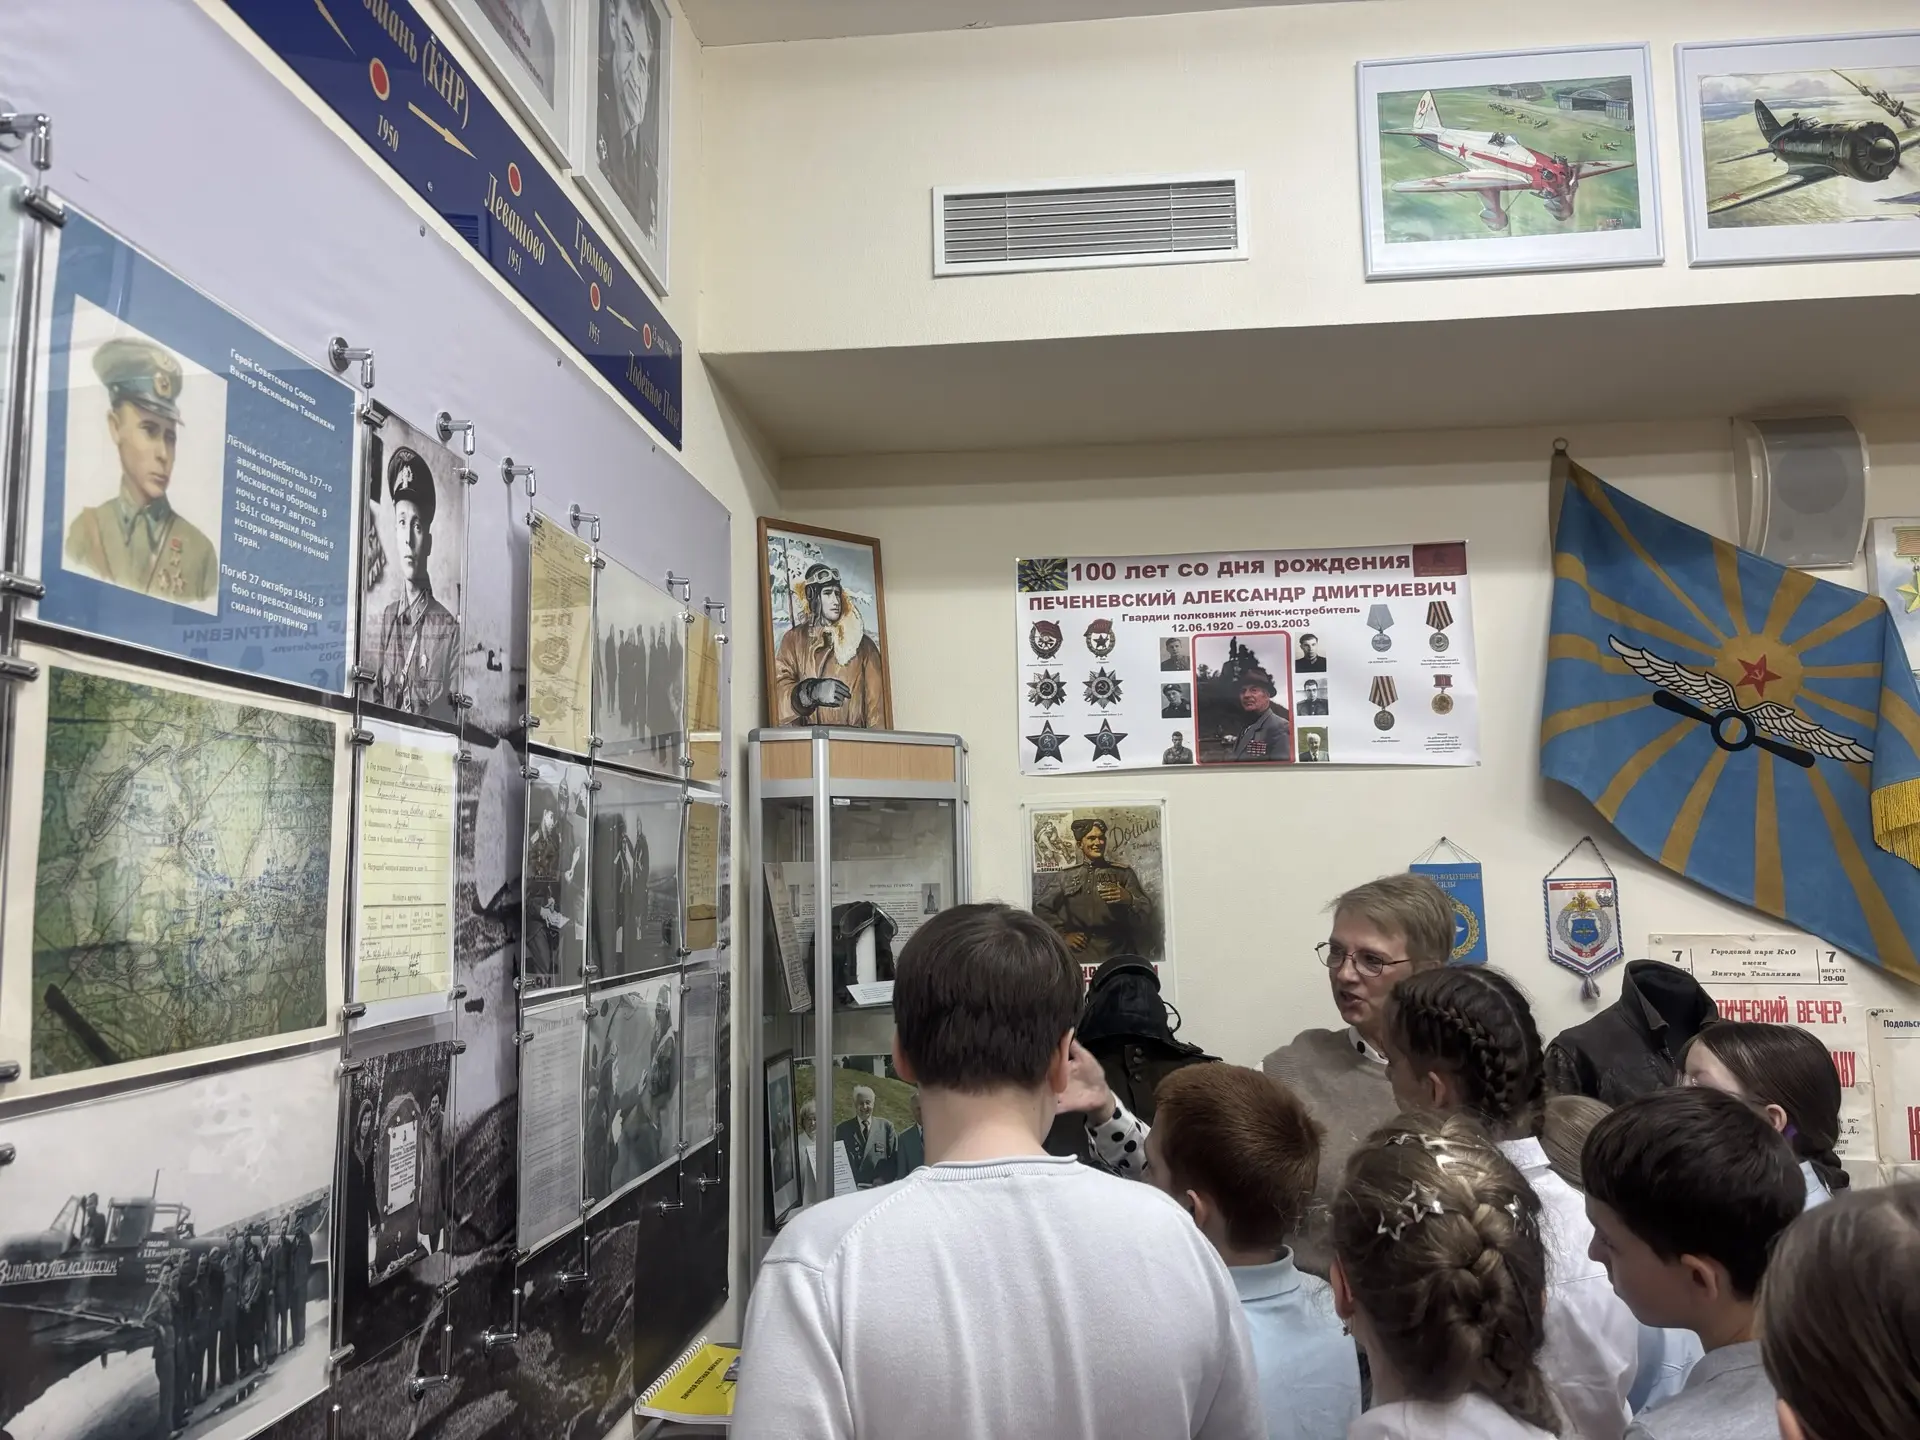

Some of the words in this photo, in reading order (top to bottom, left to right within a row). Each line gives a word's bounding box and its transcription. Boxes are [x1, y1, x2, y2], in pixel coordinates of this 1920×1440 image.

[363, 0, 417, 64] шань
[422, 40, 469, 130] (КНР)
[377, 114, 399, 152] 1950
[484, 172, 546, 266] Левашово
[507, 246, 523, 276] 1951
[574, 217, 613, 288] Громово
[588, 321, 600, 345] 1955
[230, 348, 253, 368] Герой
[254, 362, 294, 393] Советского
[294, 387, 316, 406] Союза
[625, 349, 663, 412] Лодейное
[662, 388, 681, 431] Поле
[229, 364, 257, 389] Виктор
[258, 381, 300, 412] Васильевич
[300, 404, 336, 432] Талалихин
[226, 433, 309, 482] Лётчик-истребитель
[309, 472, 334, 493] 177-го
[236, 455, 294, 489] авиационного
[294, 482, 317, 500] полка
[235, 486, 256, 502] ночь
[256, 494, 262, 505] с
[262, 496, 269, 508] 6
[270, 500, 281, 512] на
[282, 502, 288, 515] 7
[288, 507, 317, 528] августа
[236, 469, 285, 500] Московской
[286, 491, 321, 515] обороны.
[321, 507, 328, 518] В
[233, 532, 261, 550] таран.
[234, 500, 260, 519] 1941г
[260, 512, 300, 536] совершил
[300, 526, 329, 548] первый
[329, 540, 335, 550] в
[234, 517, 268, 539] истории
[269, 530, 302, 552] авиации
[302, 542, 330, 562] ночной
[221, 563, 248, 581] Погиб
[248, 572, 260, 586] 27
[261, 579, 293, 599] октября
[293, 588, 318, 606] 1941г.
[318, 596, 325, 608] В
[1071, 562, 1117, 581] 100
[1124, 564, 1170, 580] лет
[1177, 563, 1209, 577] со
[1217, 559, 1265, 577] дня
[1274, 555, 1411, 578] рождения
[231, 582, 250, 597] бою
[257, 591, 323, 621] превосходящими
[1029, 589, 1176, 611] ПЕЧЕНЕВСКИЙ
[1182, 586, 1306, 605] АЛЕКСАНДР
[1312, 582, 1457, 602] ДМИТРИЕВИЧ
[1121, 613, 1170, 623] Гвардии
[1173, 609, 1237, 621] полковник
[1240, 605, 1361, 619] лётчик-истребитель
[230, 601, 262, 619] силами
[262, 609, 309, 632] противника
[1171, 622, 1234, 633] 12.06.1920
[1246, 619, 1310, 630] 09.03.2003
[1672, 950, 1683, 963] 7
[1710, 948, 1751, 957] Городской
[1754, 949, 1774, 957] парк
[1777, 948, 1797, 956] КиО
[1820, 967, 1846, 975] августа
[1825, 951, 1837, 963] 7
[1710, 970, 1746, 978] Виктора
[1750, 970, 1801, 978] Талалихина
[1715, 996, 1789, 1023] ТИЧЕСКИЙ
[1796, 1000, 1847, 1025] ВЕЧЕР,
